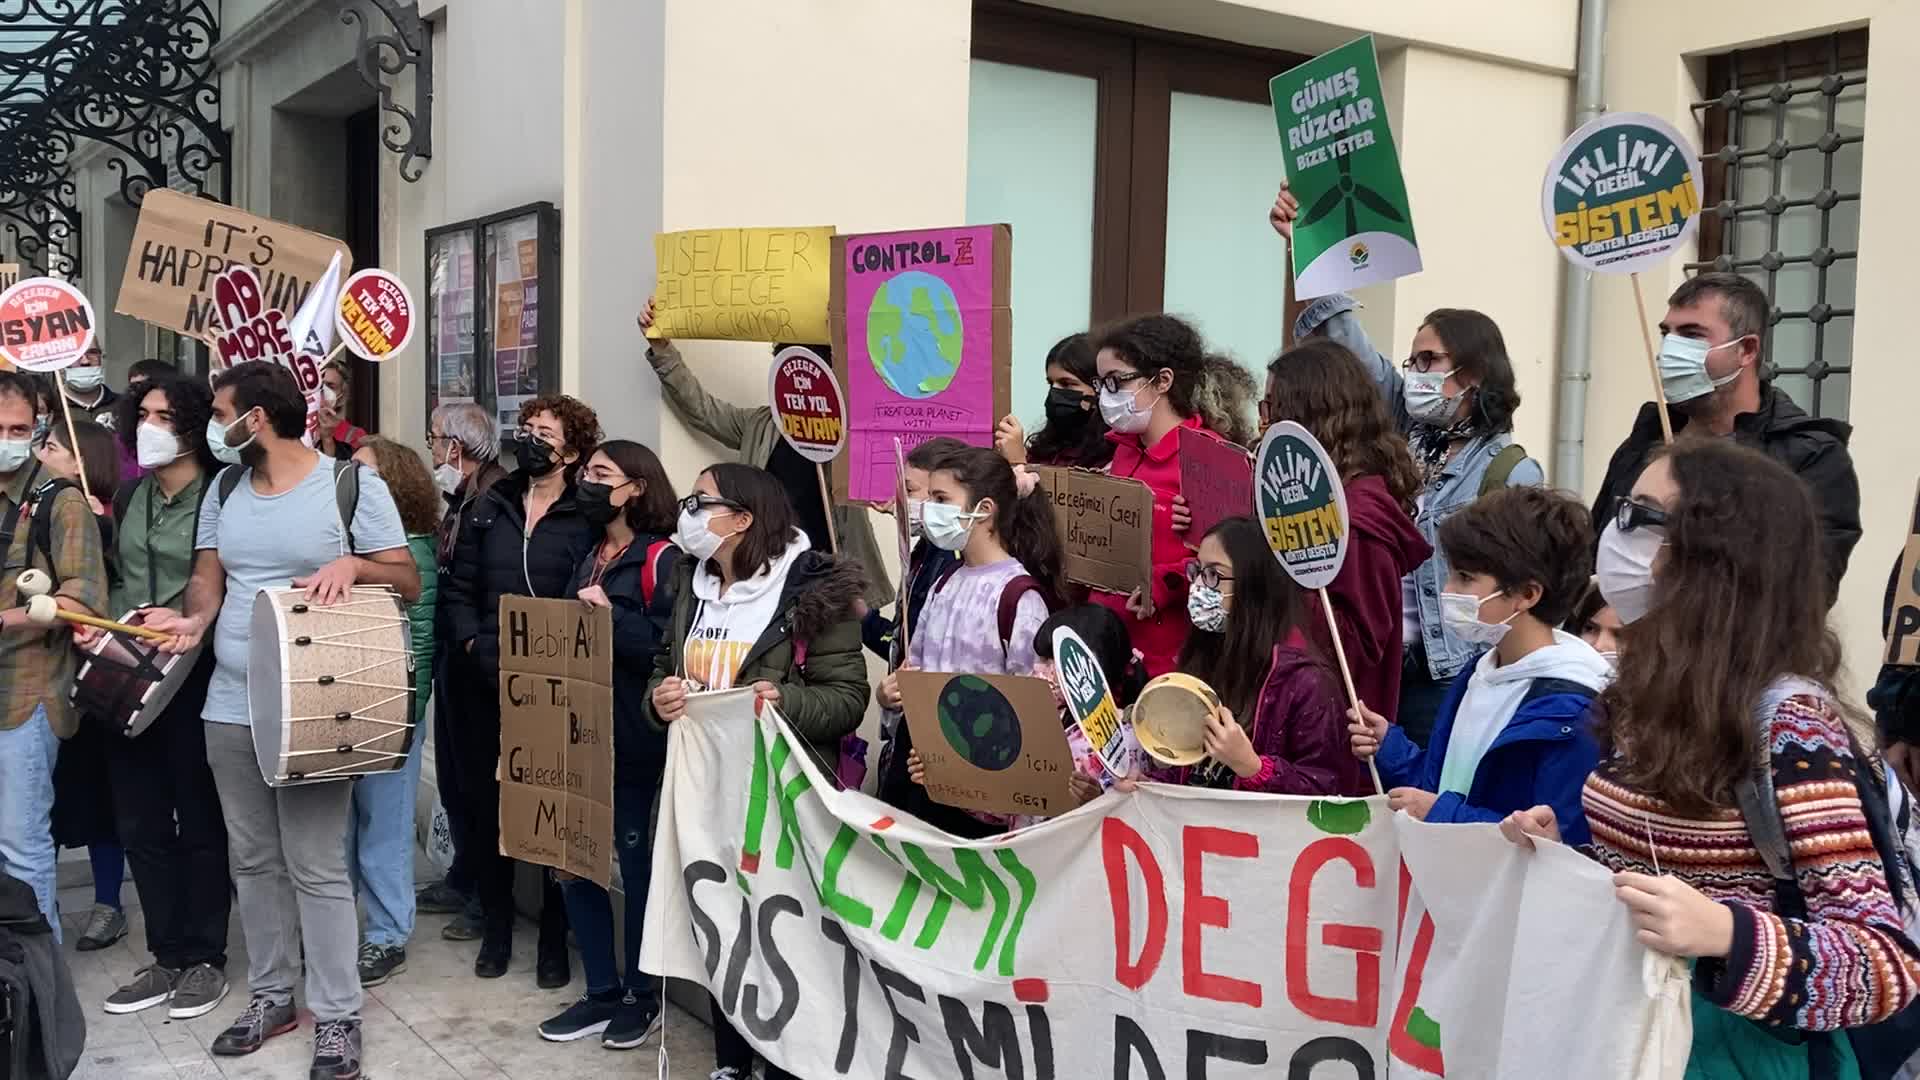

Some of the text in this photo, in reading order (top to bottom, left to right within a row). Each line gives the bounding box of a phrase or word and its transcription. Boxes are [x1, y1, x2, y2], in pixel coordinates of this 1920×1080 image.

[1291, 66, 1361, 115] GÜNEŞ
[1287, 96, 1377, 151] RÜZGAR
[1296, 129, 1376, 171] BİZE YETER
[1557, 133, 1677, 197] İKLİMİ
[1595, 168, 1646, 197] DEĞİL
[1554, 171, 1699, 247] SİSTEMİ
[203, 219, 274, 266] IT'S
[852, 237, 975, 274] CONTROL Z
[358, 288, 396, 339] TEK YOL
[783, 359, 822, 379] GEZEGEN
[784, 393, 833, 414] TEK YOL
[876, 405, 963, 421] TREAT OUR PLANET
[903, 420, 932, 429] WITH
[781, 411, 841, 441] DEVRİM
[1261, 444, 1322, 502] İKLİMİ
[1109, 495, 1141, 529] Geri
[1265, 492, 1345, 553] SİSTEMİ
